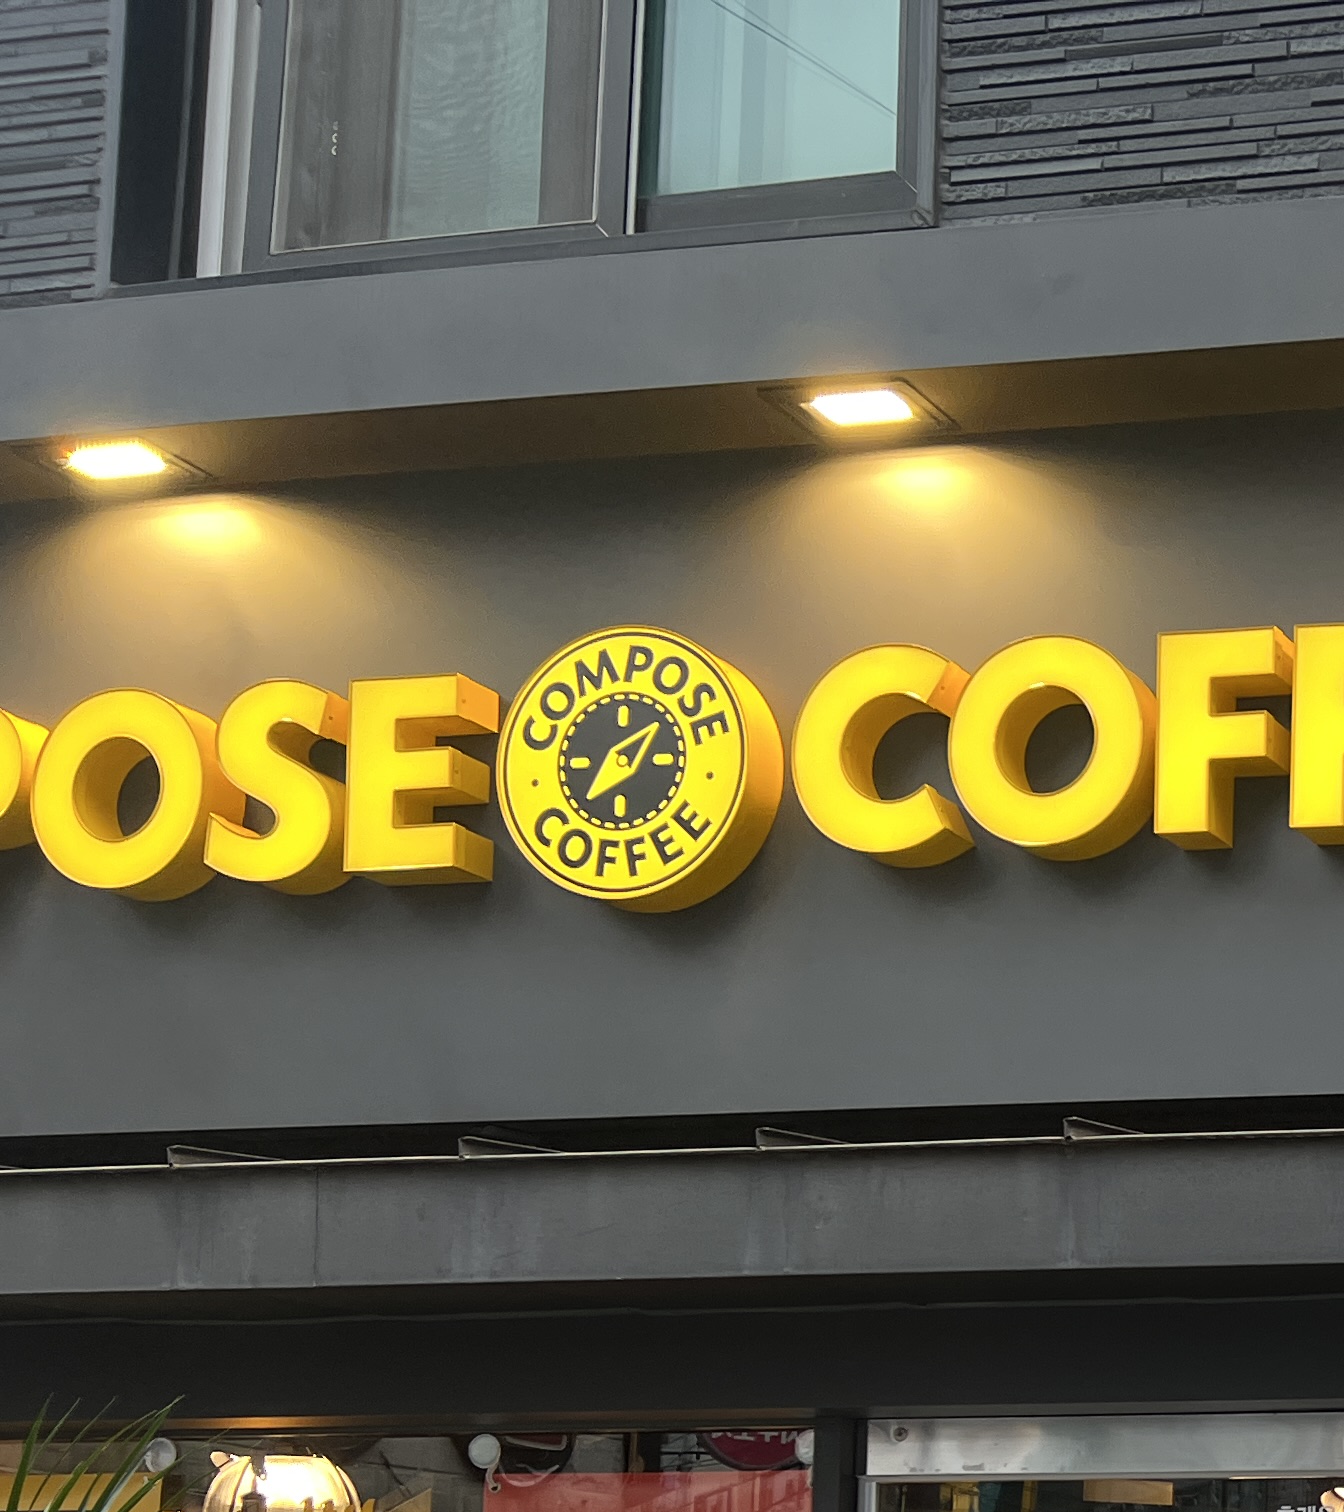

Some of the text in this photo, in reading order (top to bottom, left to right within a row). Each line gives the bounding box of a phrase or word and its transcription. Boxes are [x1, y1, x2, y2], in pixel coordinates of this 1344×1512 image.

[520, 643, 730, 752] COMPOSE
[0, 673, 500, 902] OSE
[532, 800, 714, 880] COFFEE
